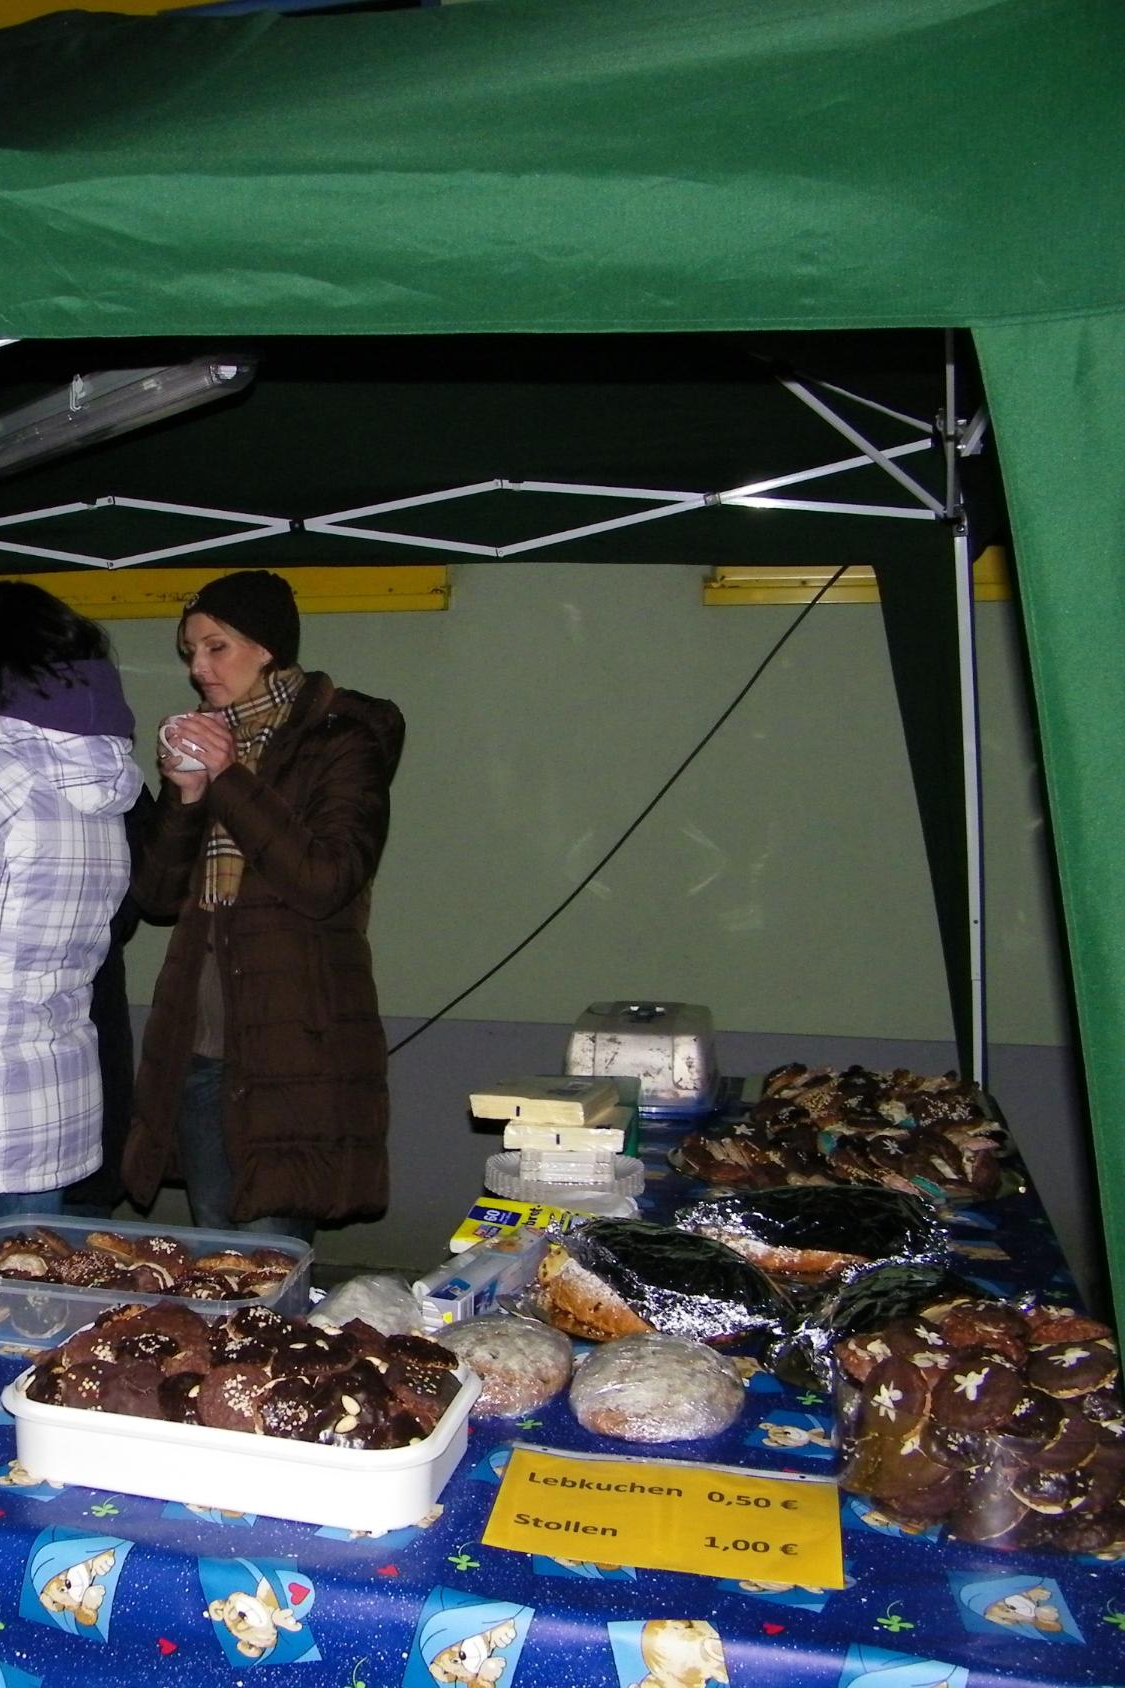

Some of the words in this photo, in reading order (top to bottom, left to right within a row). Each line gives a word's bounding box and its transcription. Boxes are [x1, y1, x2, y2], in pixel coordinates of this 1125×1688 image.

[483, 1209, 500, 1222] 60
[528, 1472, 683, 1497] Lebkuchen
[707, 1491, 772, 1509] 0,50
[780, 1499, 799, 1510] €
[514, 1513, 618, 1537] Stollen
[704, 1536, 771, 1554] 1,00
[780, 1543, 799, 1556] €
